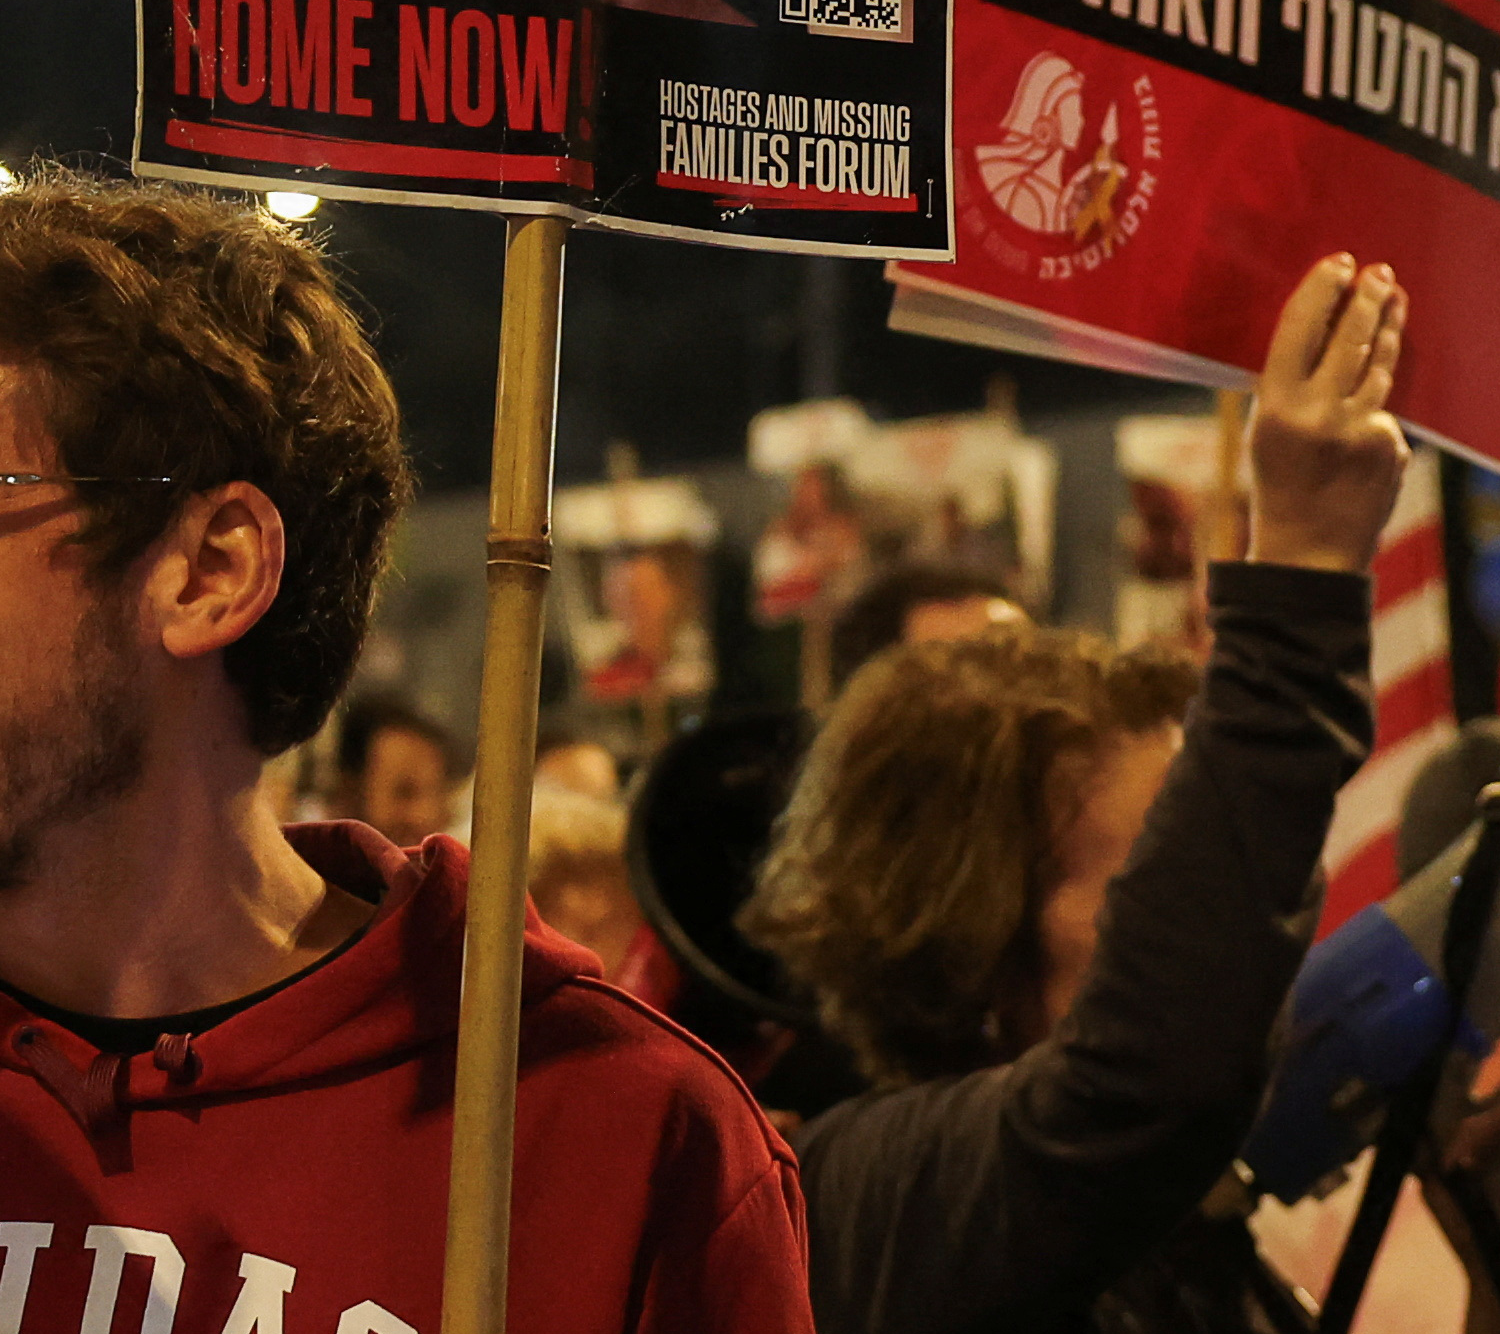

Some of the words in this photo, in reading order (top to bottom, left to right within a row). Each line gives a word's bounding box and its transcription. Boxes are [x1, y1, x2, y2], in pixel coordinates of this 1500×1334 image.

[658, 78, 762, 126] HOSTAGES
[765, 92, 808, 133] AND
[813, 98, 912, 143] MISSING
[658, 117, 790, 191] FAMILIES
[794, 137, 912, 201] FORUM
